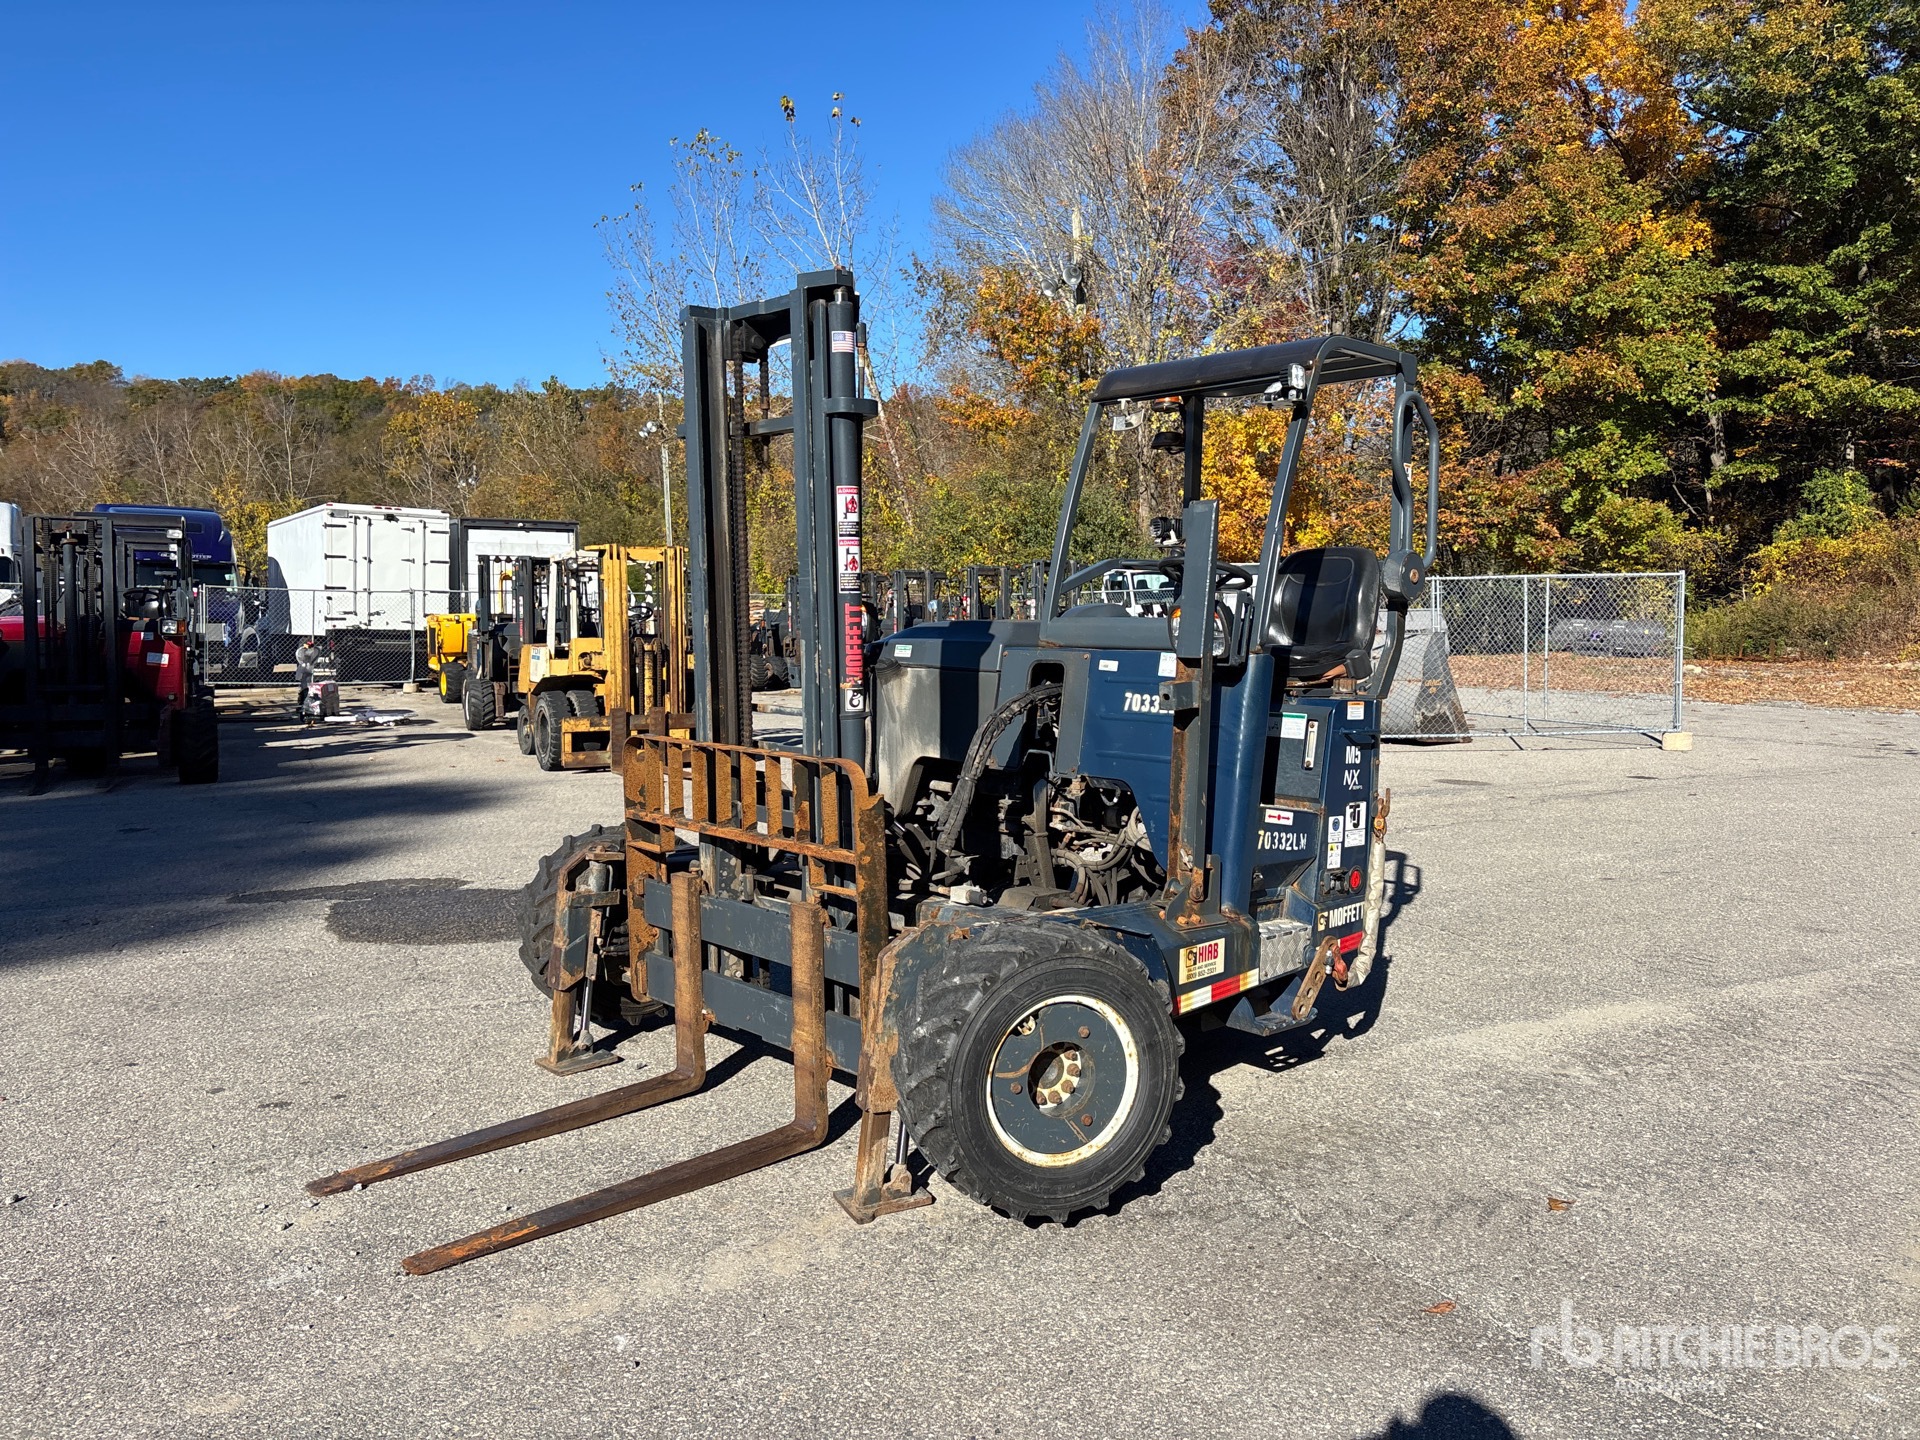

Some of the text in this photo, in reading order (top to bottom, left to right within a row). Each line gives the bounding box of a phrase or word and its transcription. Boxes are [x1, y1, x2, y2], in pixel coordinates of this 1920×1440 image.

[1124, 692, 1175, 713] 7033
[1345, 745, 1361, 764] M5
[1343, 769, 1361, 790] NX
[1328, 902, 1364, 928] MOFFETT
[1198, 943, 1218, 963] HIAB
